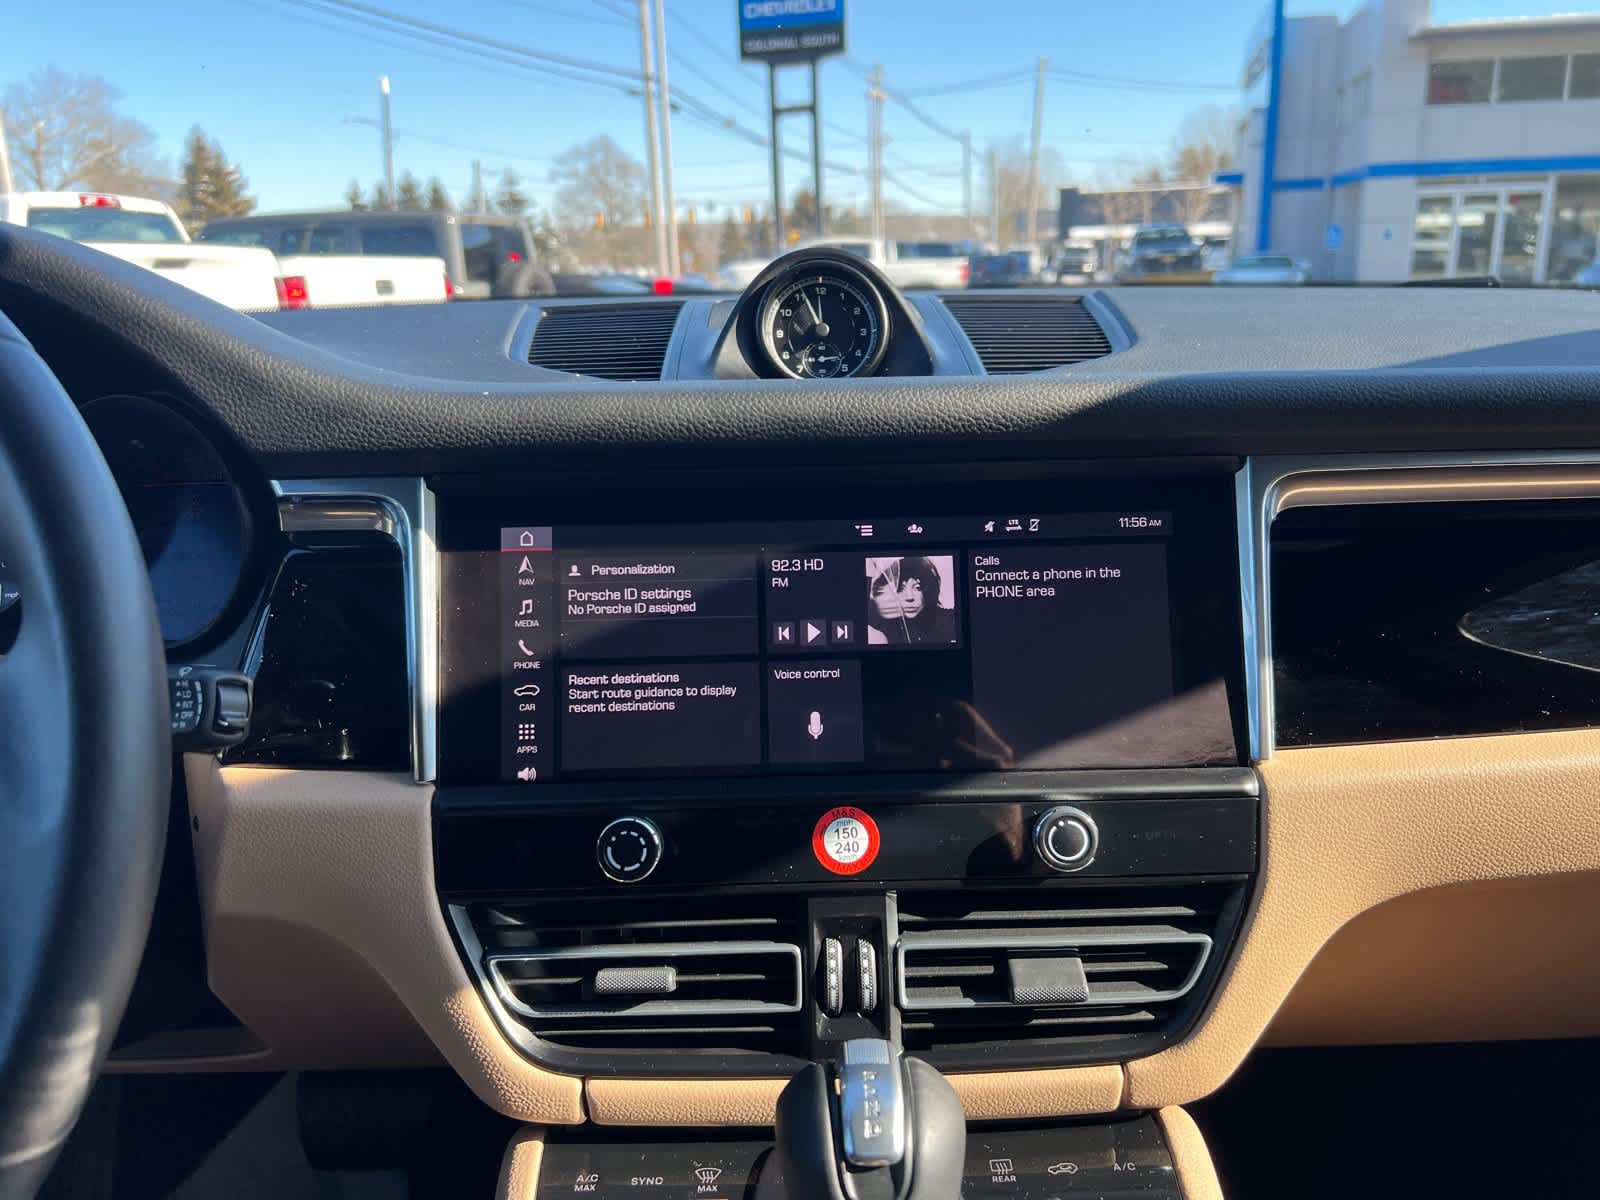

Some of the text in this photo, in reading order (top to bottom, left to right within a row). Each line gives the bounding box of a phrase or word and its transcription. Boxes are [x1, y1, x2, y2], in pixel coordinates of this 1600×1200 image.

[815, 287, 827, 295] 12
[780, 309, 792, 317] 10
[854, 307, 861, 315] 2
[776, 329, 784, 338] 9
[860, 328, 867, 336] 3
[796, 365, 803, 373] 7
[1119, 517, 1147, 527] 11:56
[772, 559, 823, 571] 92.3 HD
[975, 556, 1000, 565] Calls
[592, 564, 675, 575] Personalization
[976, 567, 1120, 581] Connect a phone in the
[772, 578, 788, 587] FM
[568, 588, 691, 601] Porsche ID settings
[976, 585, 1055, 597] PHONE area
[568, 602, 696, 614] No Porsche ID assigned
[514, 661, 540, 669] PHONE
[774, 668, 840, 679] Voice control
[569, 673, 679, 685] Recent destinations
[182, 690, 193, 699] LO
[569, 685, 736, 699] Start route guidance to display
[569, 701, 675, 712] recent destinations
[832, 807, 857, 818] M&S
[834, 827, 858, 840] 150
[834, 841, 859, 854] 240
[1113, 1162, 1135, 1171] A/C
[631, 1177, 663, 1185] SYNC
[698, 1185, 717, 1193] MAX
